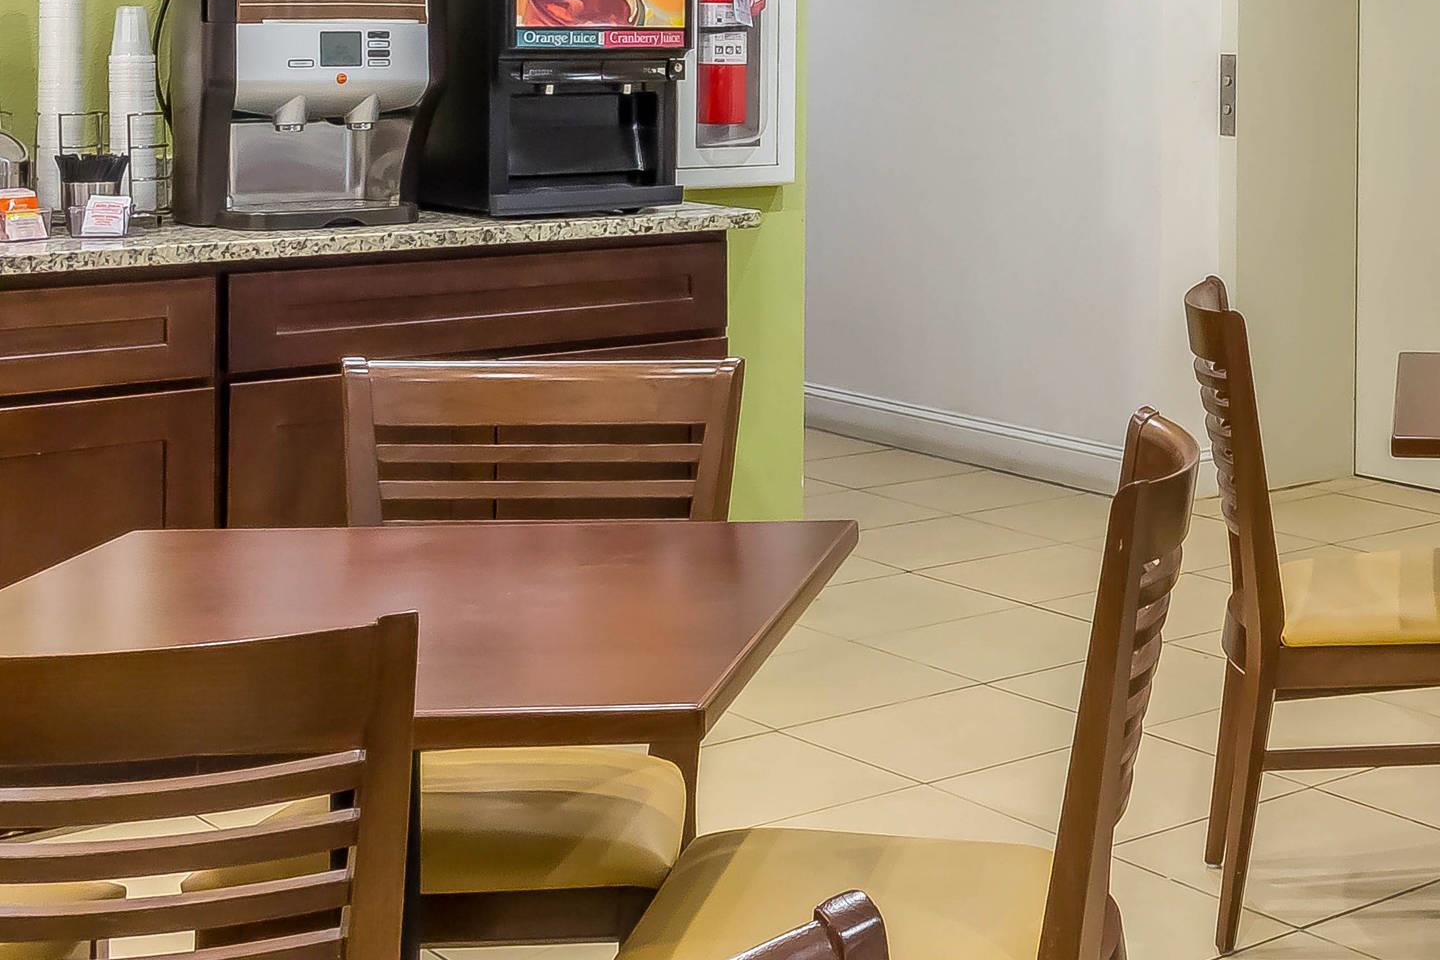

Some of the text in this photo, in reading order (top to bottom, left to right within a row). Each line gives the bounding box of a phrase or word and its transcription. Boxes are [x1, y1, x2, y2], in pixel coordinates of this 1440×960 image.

[523, 31, 597, 46] Orange Juice
[609, 31, 681, 46] Cranberry Juice
